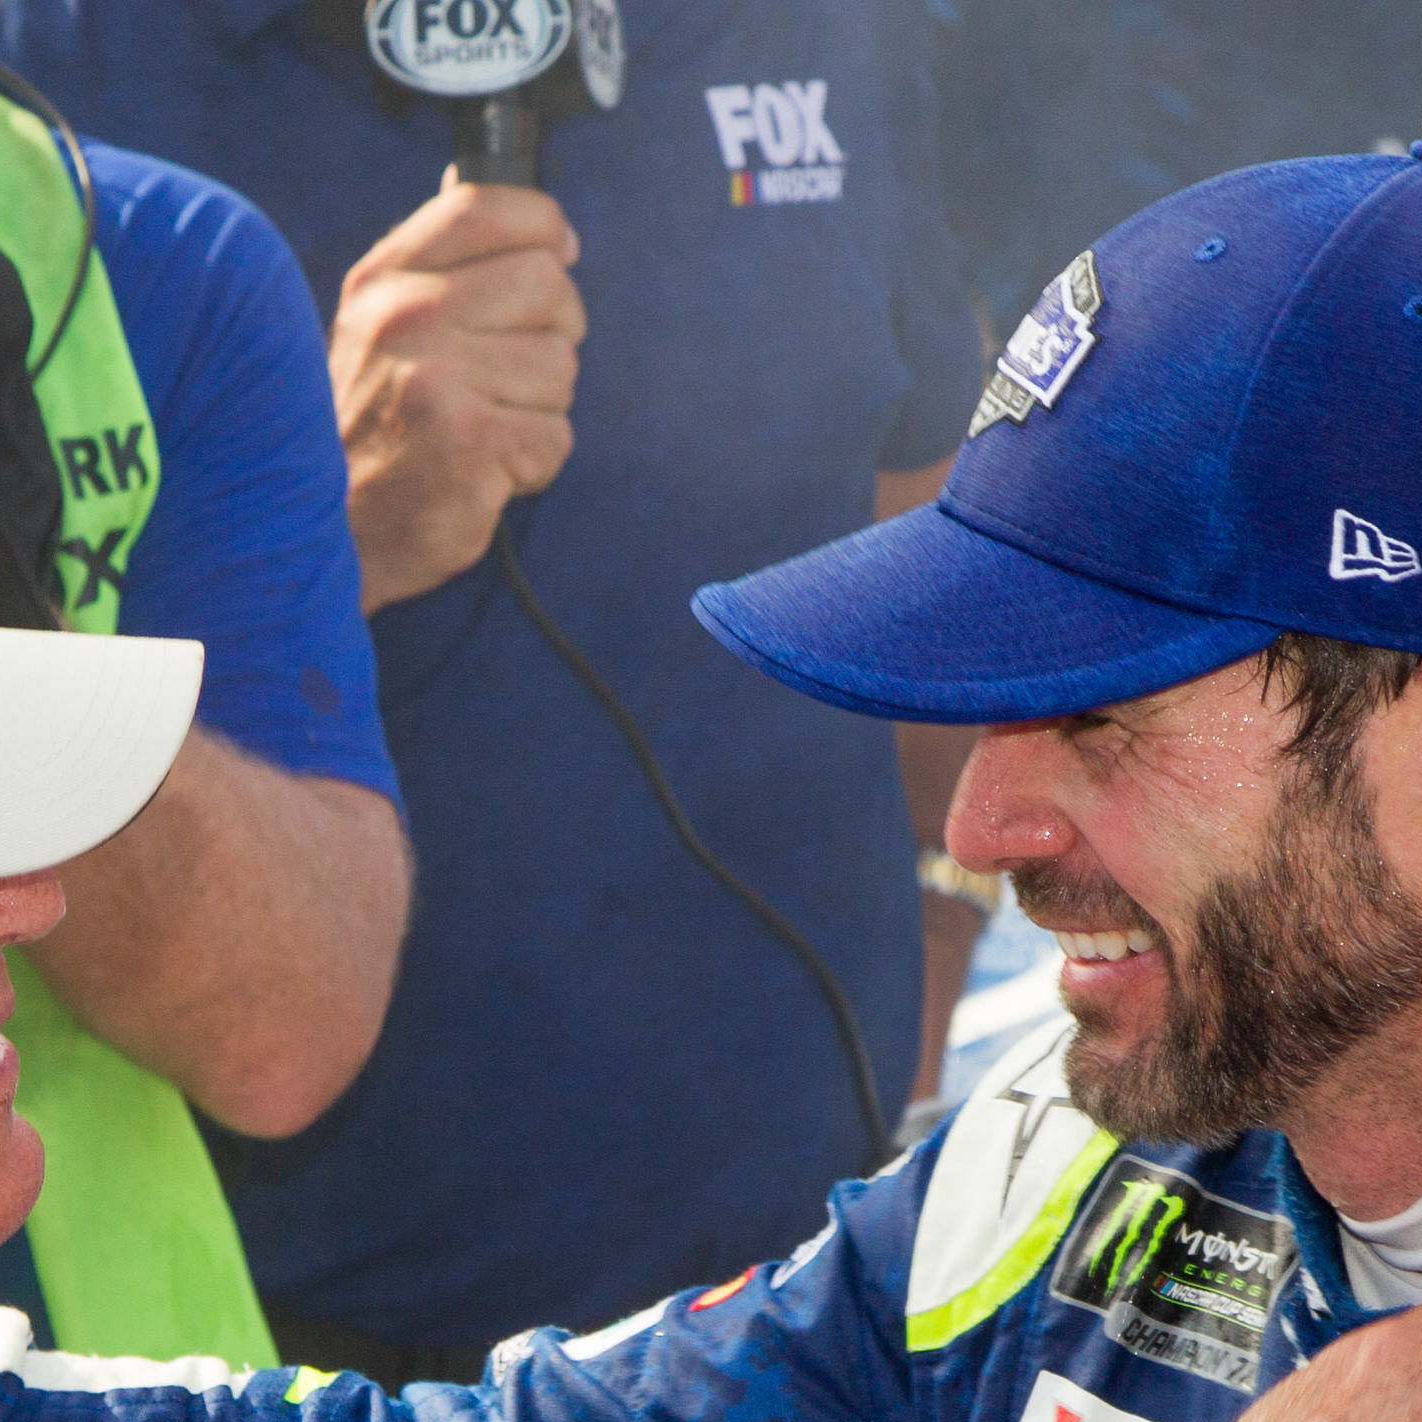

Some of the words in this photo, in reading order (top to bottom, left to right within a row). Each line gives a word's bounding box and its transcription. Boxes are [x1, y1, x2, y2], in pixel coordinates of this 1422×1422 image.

[414, 0, 522, 43] FOX
[415, 40, 532, 65] SPORTS
[704, 78, 843, 171] FOX
[59, 423, 147, 500] RK
